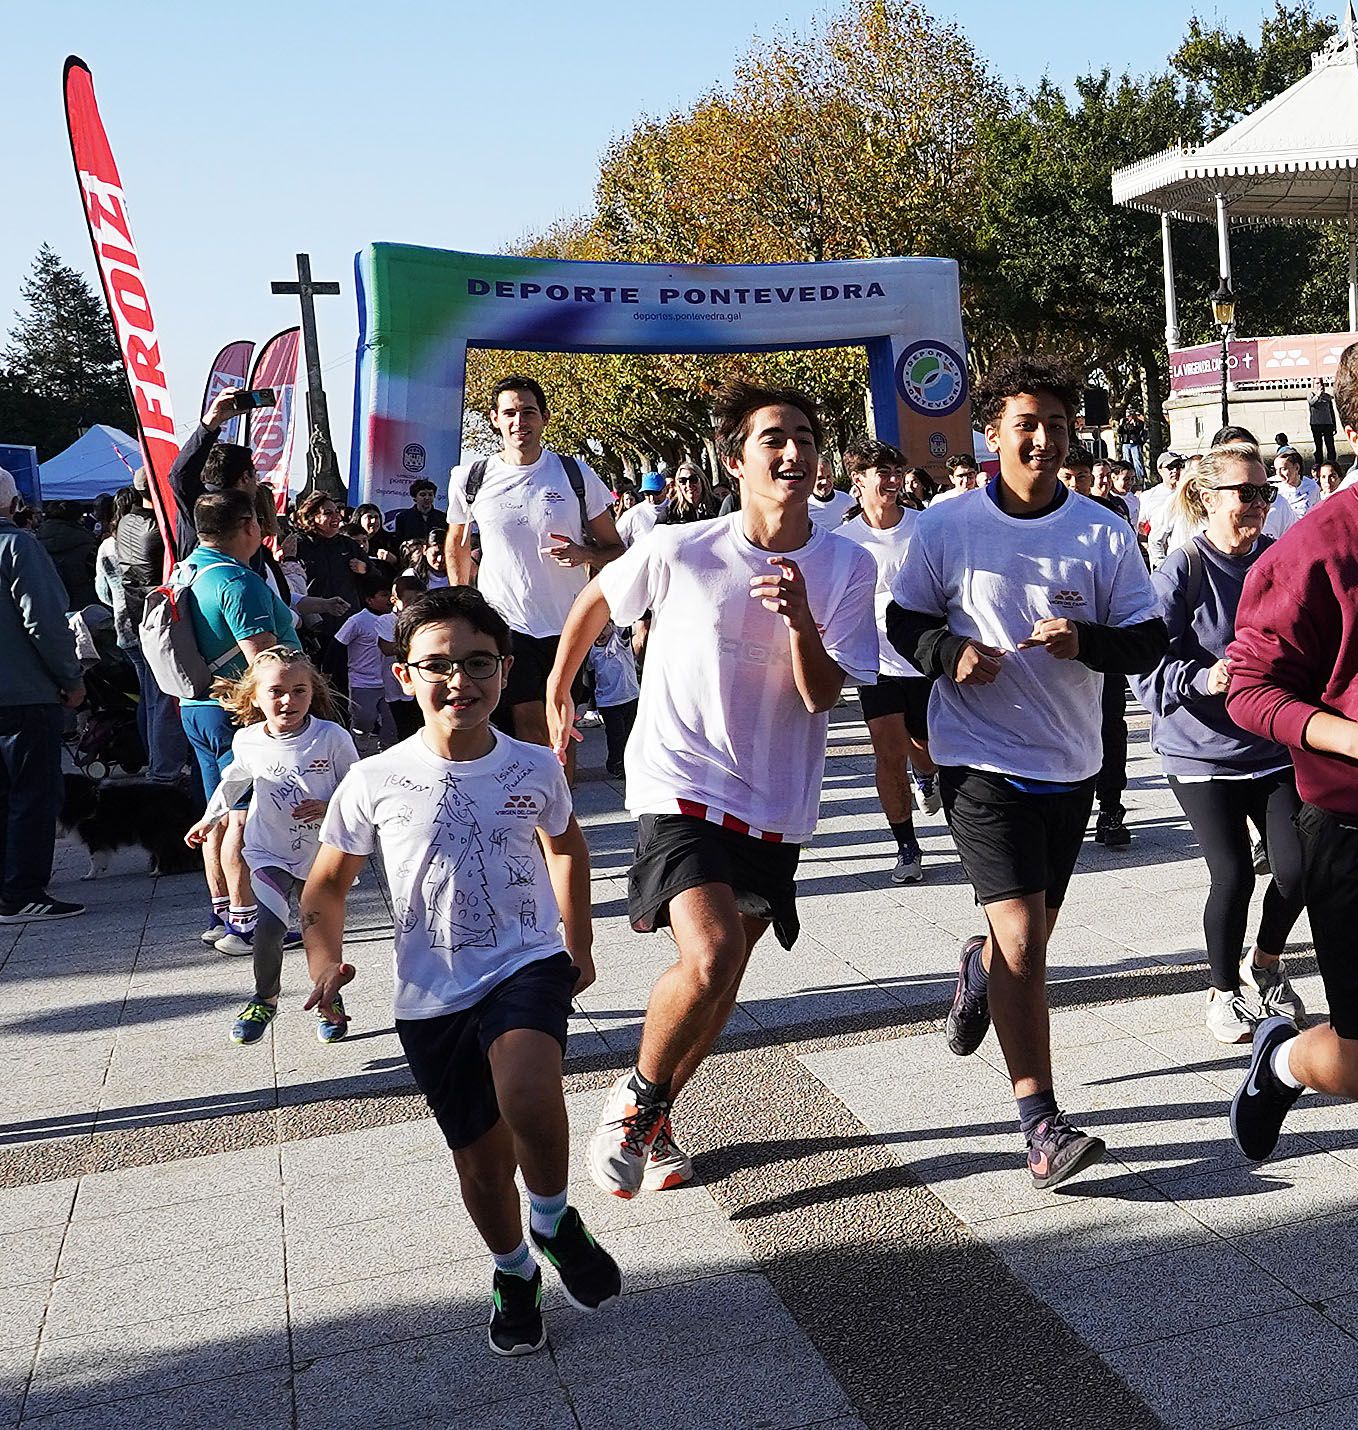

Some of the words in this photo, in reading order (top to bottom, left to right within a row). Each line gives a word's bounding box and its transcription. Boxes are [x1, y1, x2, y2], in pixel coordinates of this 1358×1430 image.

[466, 278, 639, 304] DEPORTE
[659, 282, 886, 305] PONTEVEDRA
[86, 184, 175, 436] FROIZ
[632, 310, 742, 322] deportes.pontevedra.gal
[908, 350, 955, 368] DEPORTE
[905, 380, 961, 408] PONTEVEDRA
